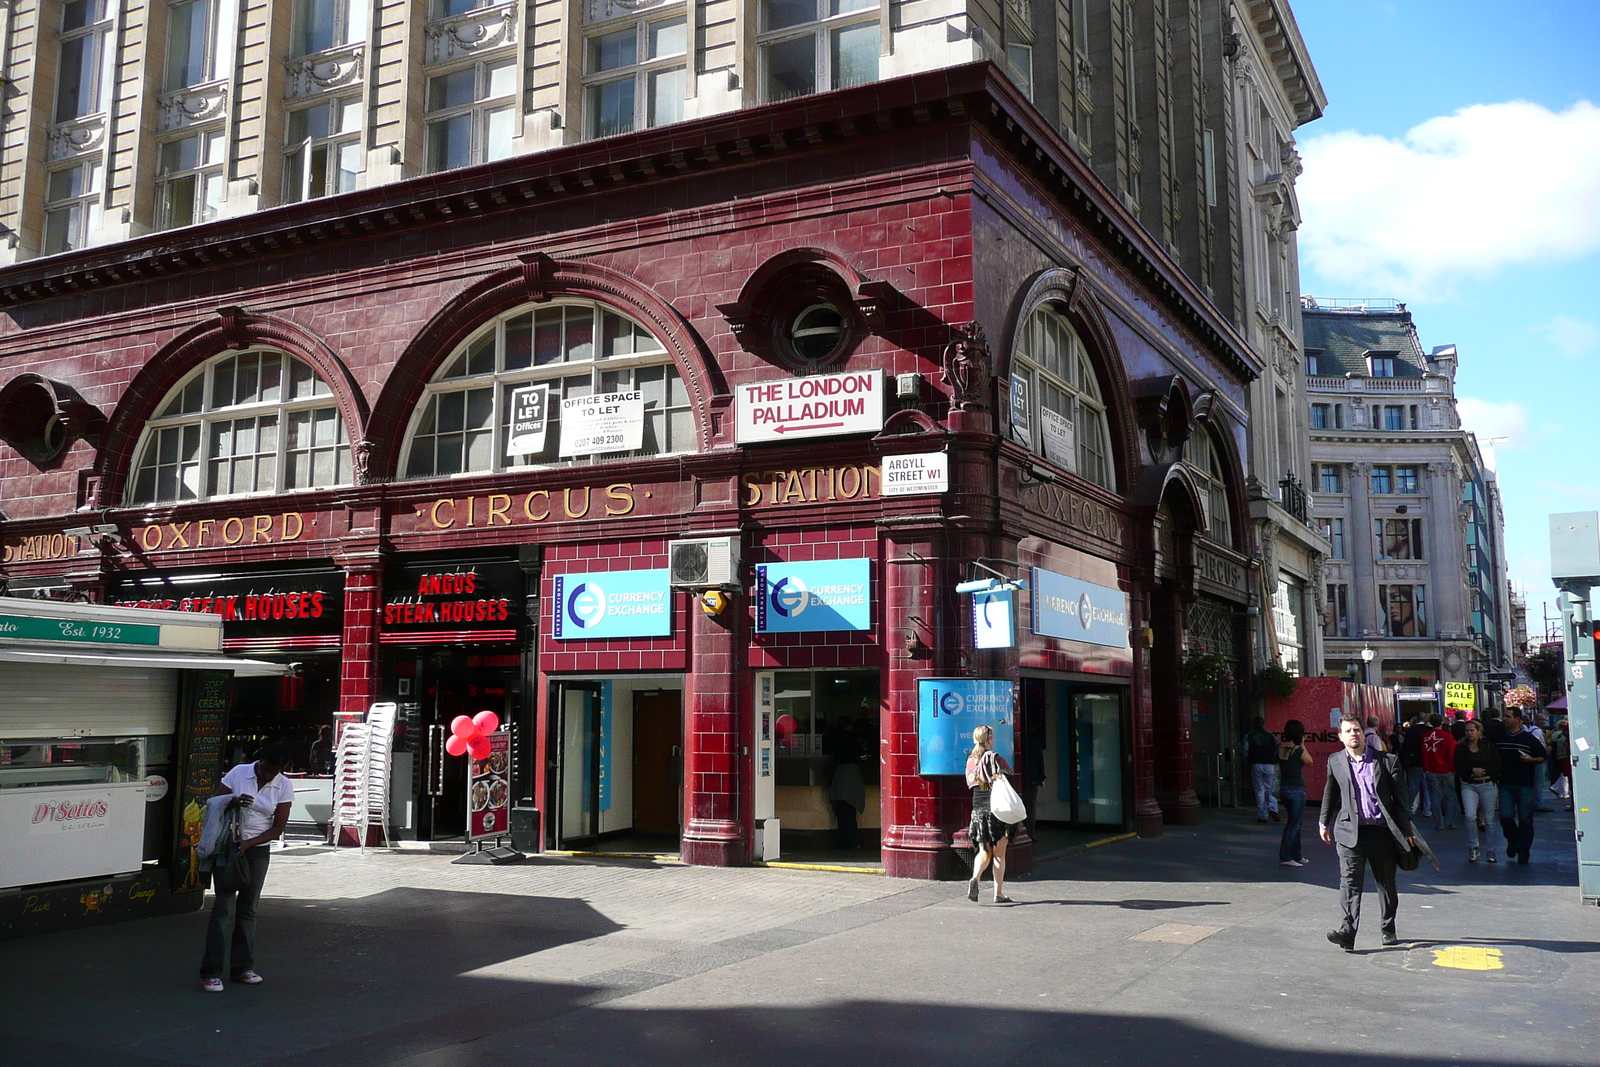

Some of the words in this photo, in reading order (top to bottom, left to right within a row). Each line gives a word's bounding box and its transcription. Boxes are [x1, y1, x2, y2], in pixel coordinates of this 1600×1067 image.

[746, 384, 783, 403] THE
[789, 374, 872, 399] LONDON
[1013, 381, 1023, 396] TO
[521, 392, 539, 405] TO
[564, 395, 600, 409] OFFICE
[604, 392, 641, 403] SPACE
[1013, 395, 1025, 410] LET
[518, 405, 541, 420] LET
[581, 408, 595, 416] TO
[599, 406, 620, 414] LET
[753, 398, 864, 425] PALLADIUM
[1043, 408, 1059, 424] OFFICE
[515, 422, 541, 431] Offices
[1050, 423, 1056, 433] TO
[1057, 427, 1066, 437] LET
[592, 436, 605, 445] 409
[607, 434, 624, 444] 2300
[889, 458, 925, 470] ARGYLL
[889, 470, 923, 482] STREET
[927, 469, 941, 479] W1
[741, 461, 883, 506] STATION
[906, 484, 938, 492] WESTMINSTER
[430, 483, 634, 528] CIRCUS
[1037, 483, 1119, 541] OXFORD
[143, 512, 304, 550] OXFORD
[1196, 551, 1237, 587] CIRCUS
[418, 573, 476, 595] ANGUS
[811, 584, 865, 595] CURRENCY
[609, 591, 665, 603] CURRENCY
[811, 595, 865, 606] EXCHANGE
[180, 595, 237, 621] STEAK
[245, 591, 324, 620] HOUSES
[384, 602, 435, 624] STEAK
[441, 599, 509, 622] HOUSES
[609, 603, 665, 616] EXCHANGE
[1042, 594, 1080, 616] CURRENCY
[1092, 606, 1125, 626] EXCHANGE
[58, 621, 87, 637] Est.
[92, 626, 121, 639] 1932
[205, 680, 224, 689] SOFT
[1446, 683, 1474, 691] GOLF
[206, 690, 219, 699] ICE
[966, 694, 1006, 703] CURRENCY
[1446, 691, 1473, 699] SALE
[198, 699, 225, 709] CREAM
[966, 704, 1006, 713] EXCHANGE
[32, 799, 109, 824] DiSotto's
